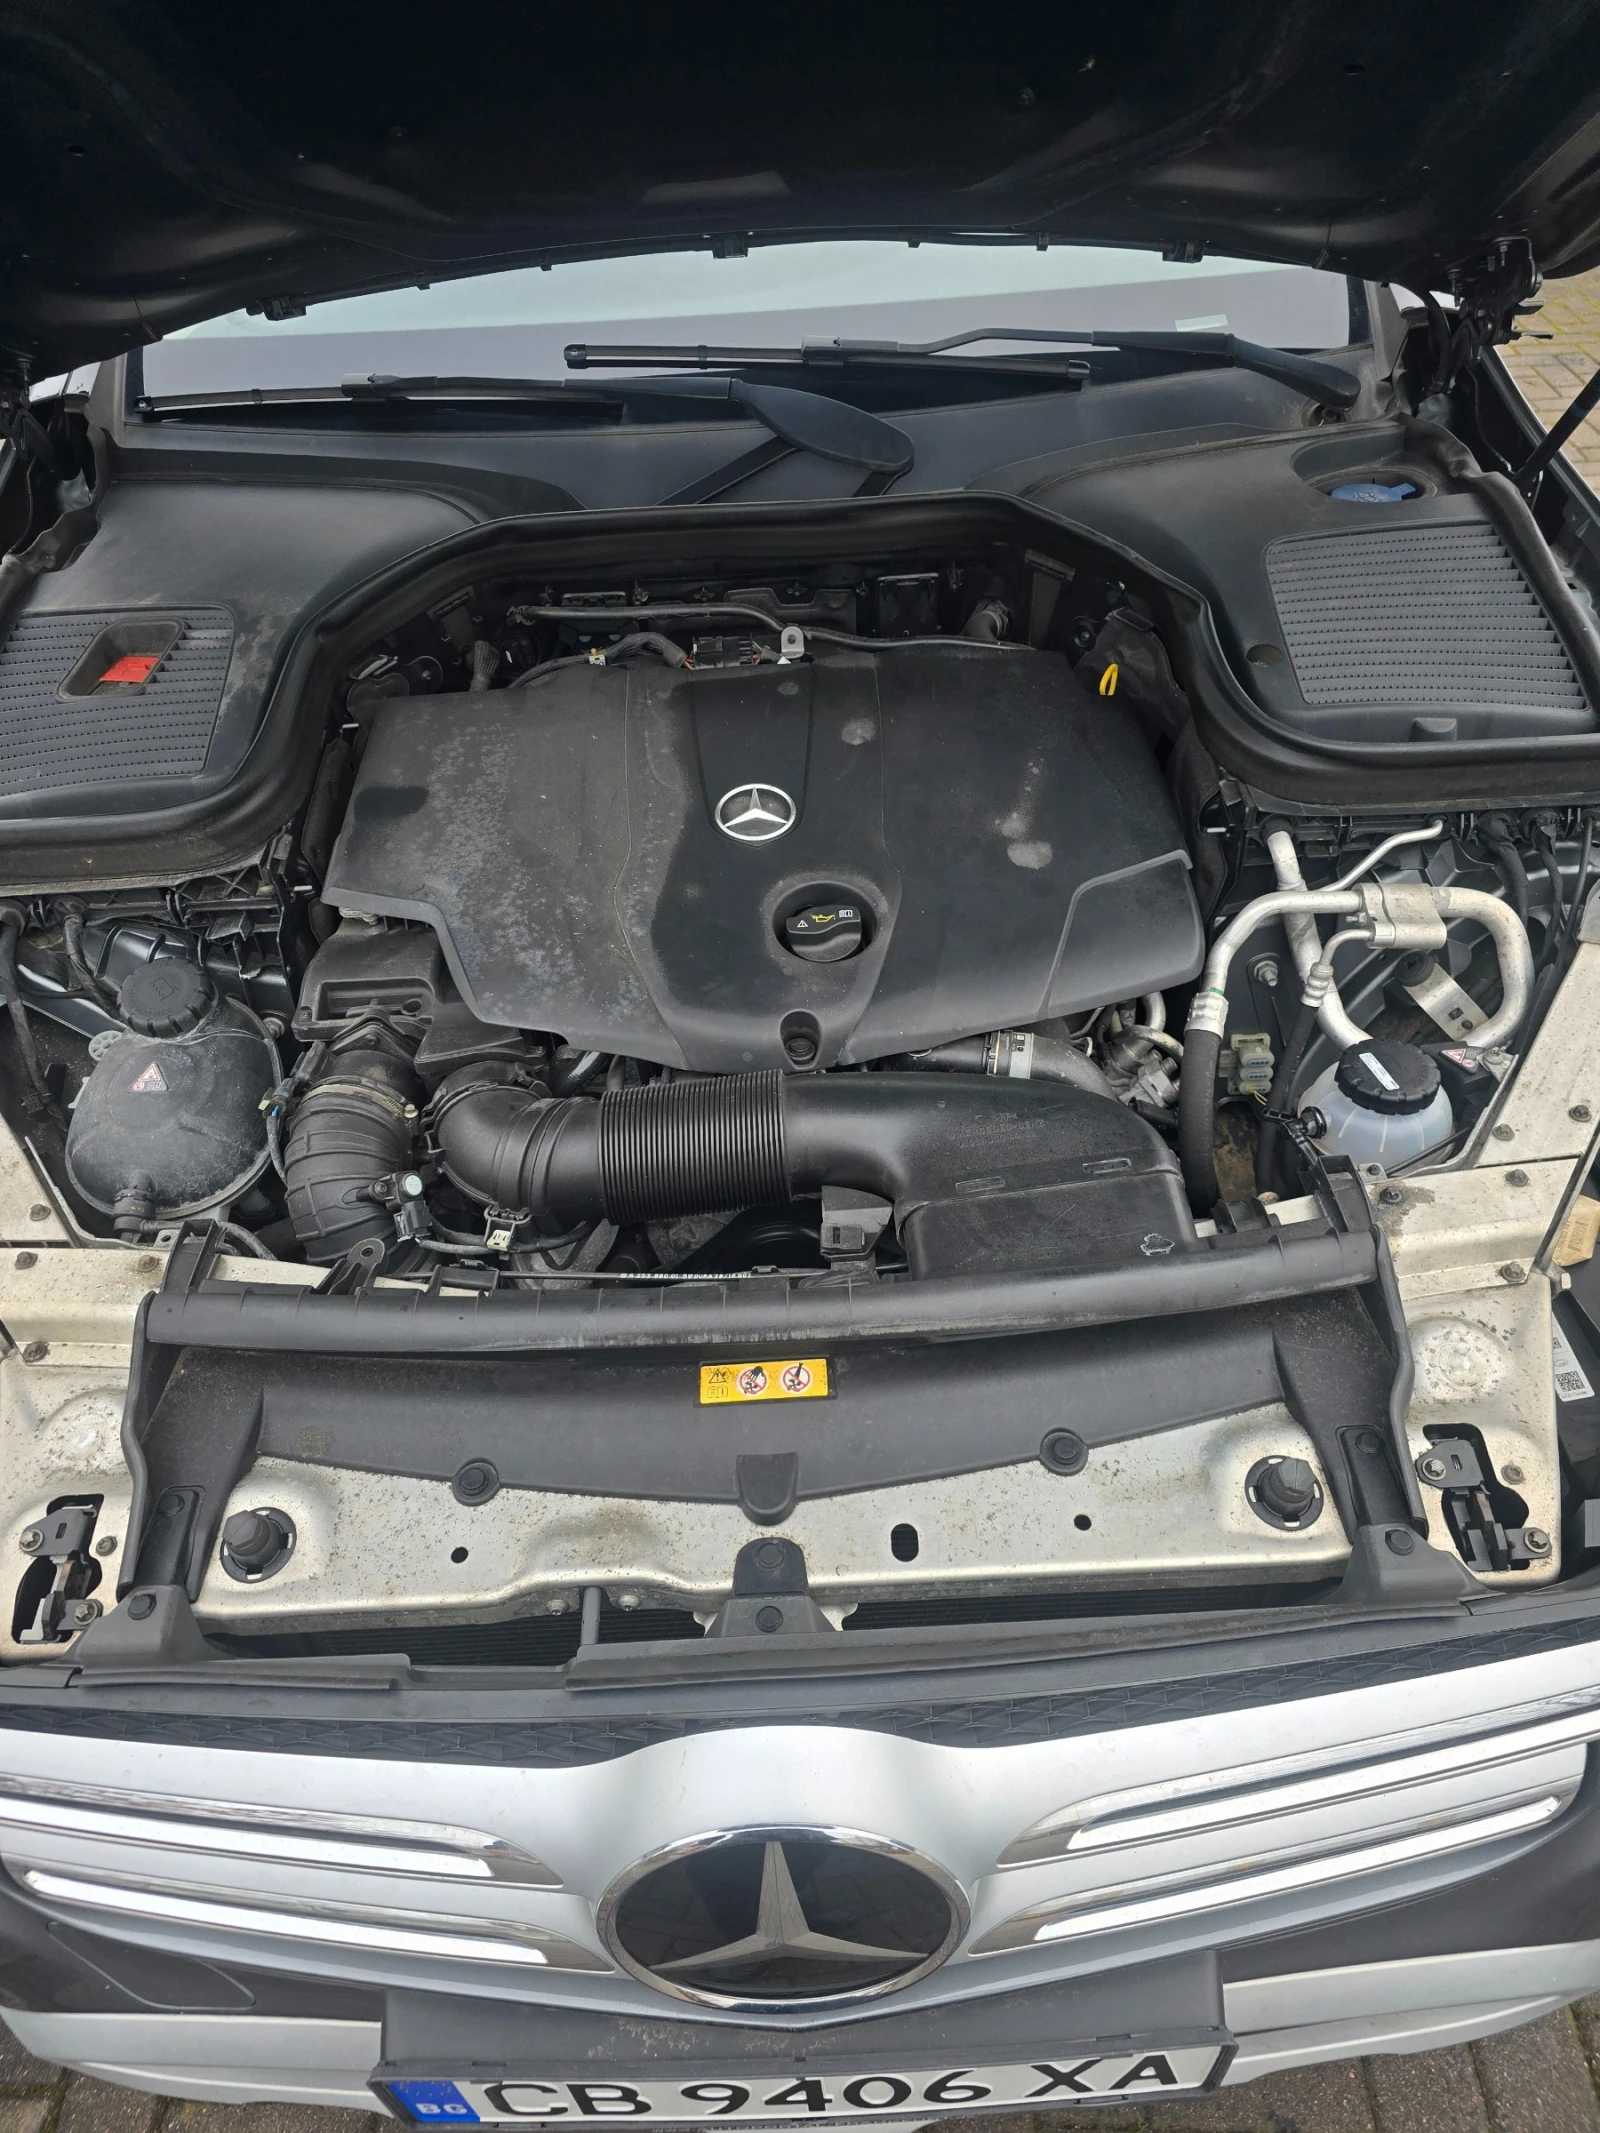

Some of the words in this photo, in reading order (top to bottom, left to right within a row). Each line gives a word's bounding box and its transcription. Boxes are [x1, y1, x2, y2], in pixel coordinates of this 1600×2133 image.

[484, 2083, 652, 2116] CB
[680, 2070, 991, 2115] 9406
[1024, 2054, 1179, 2098] XA
[416, 2103, 467, 2115] BG
